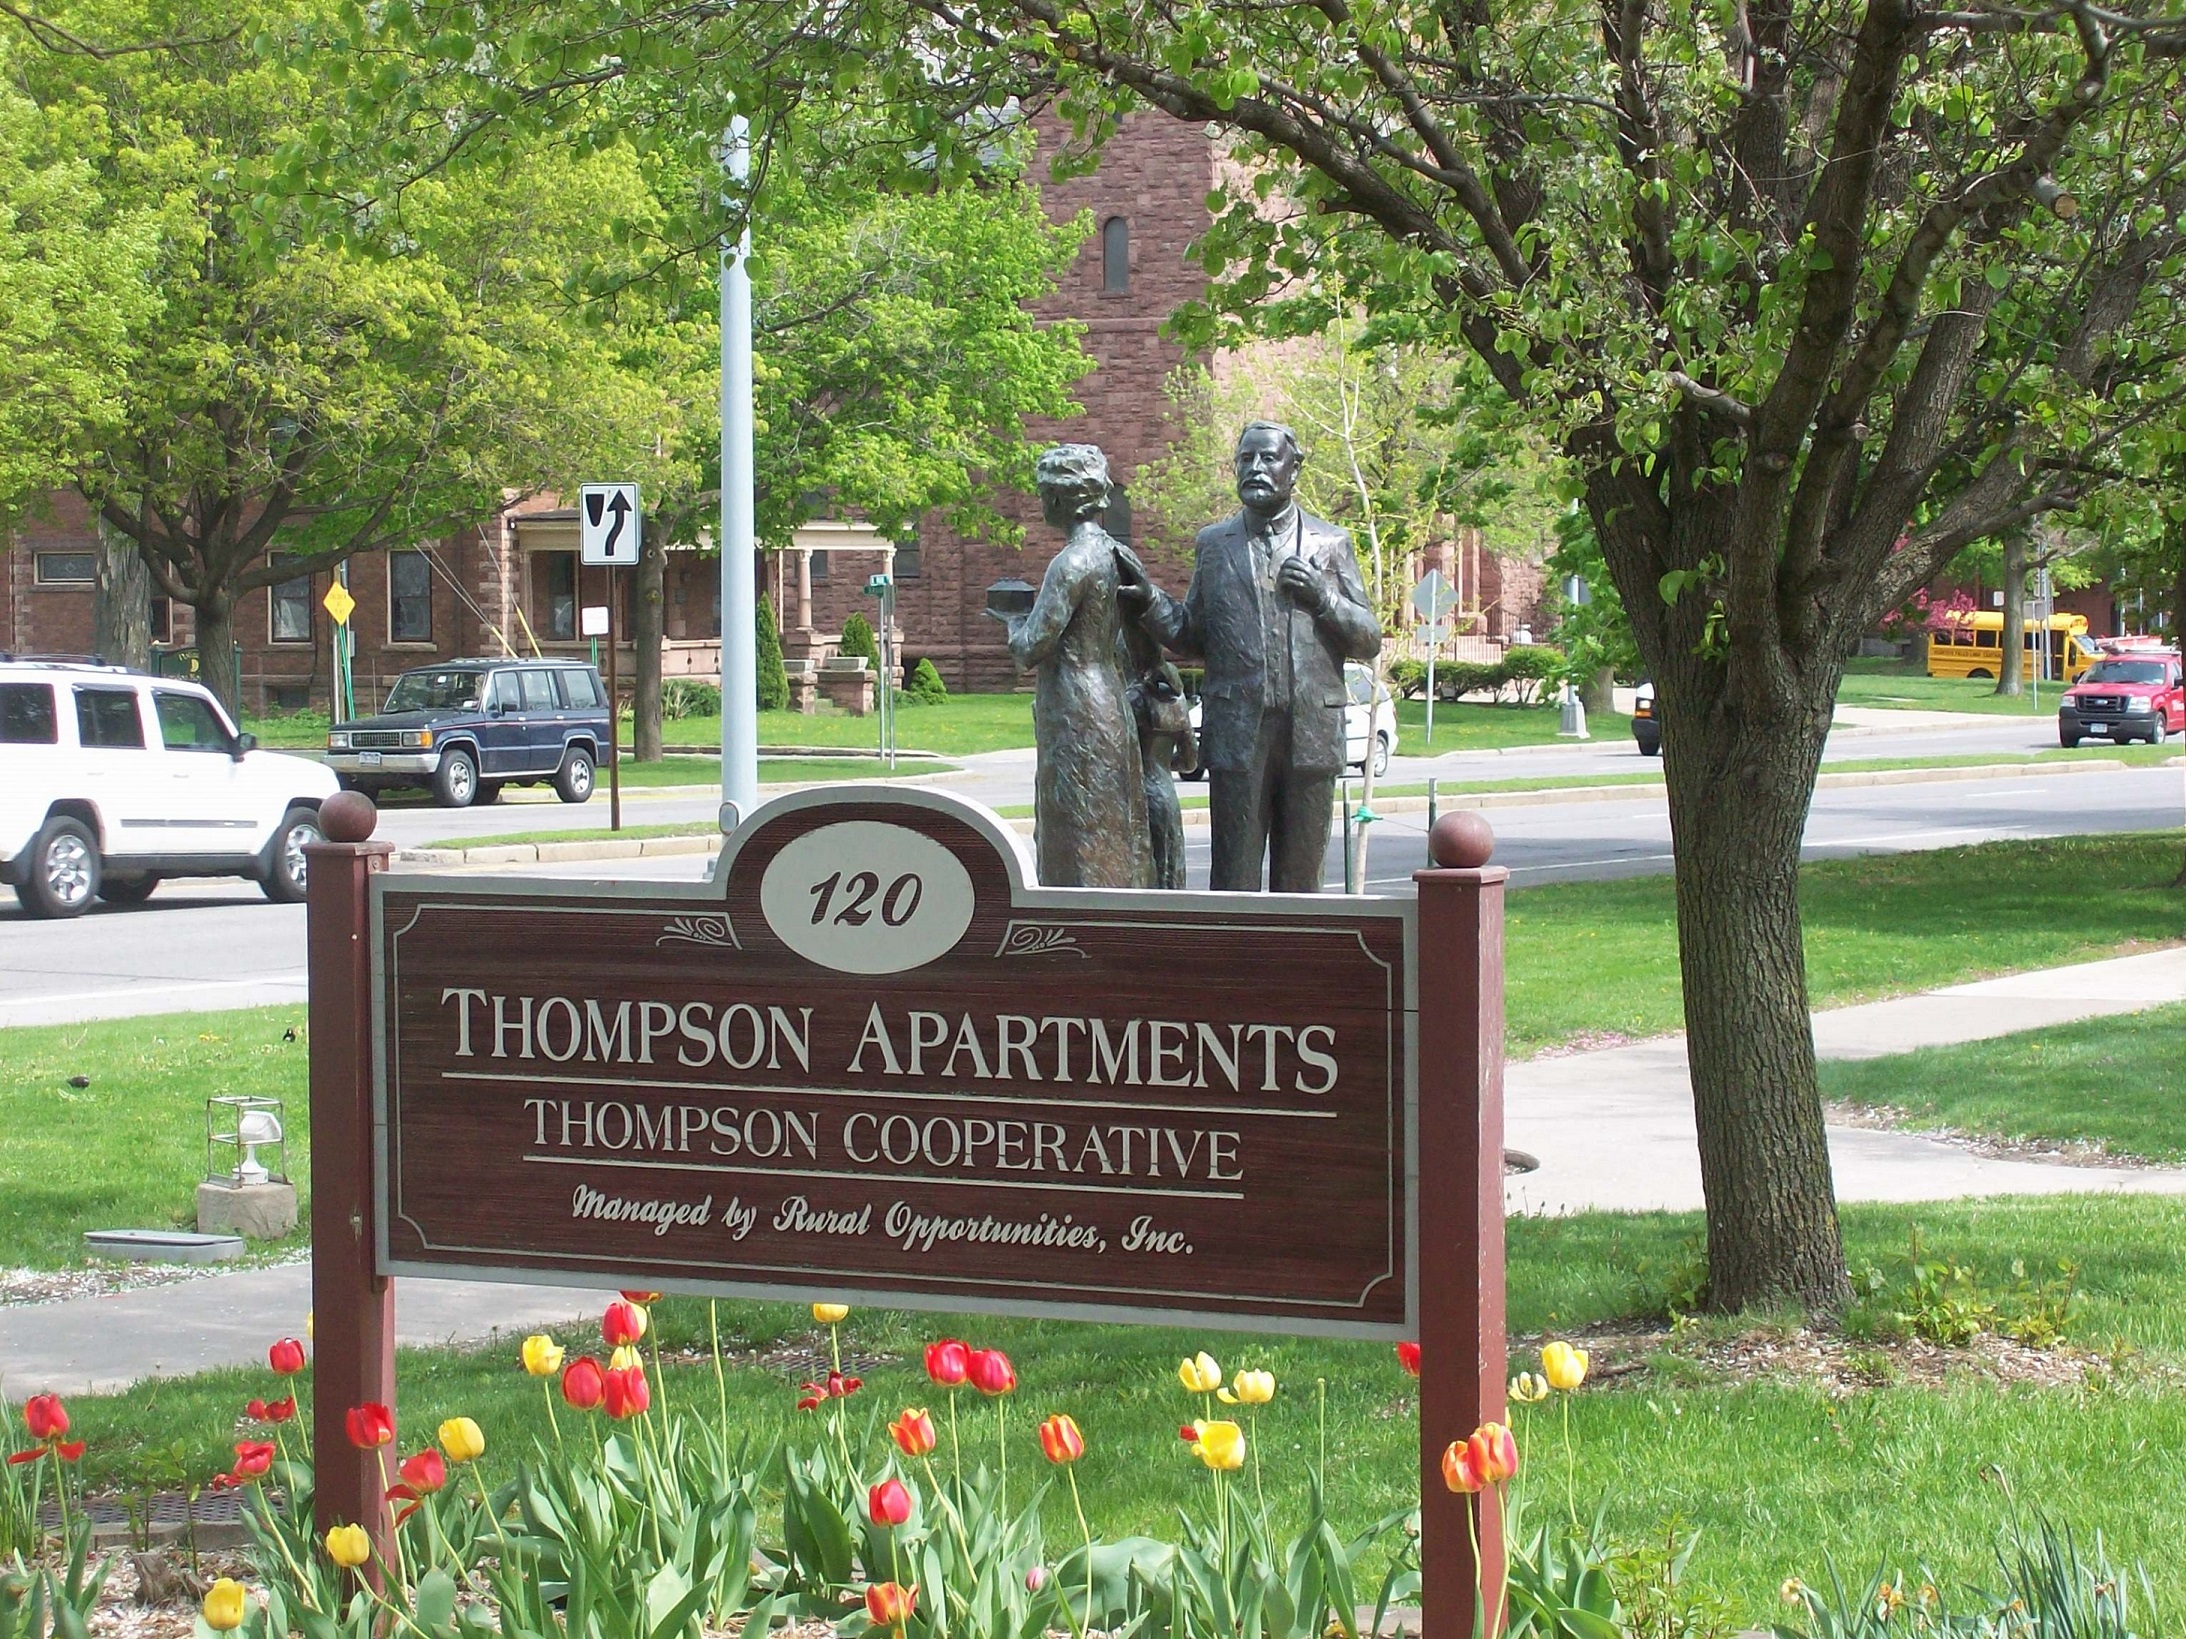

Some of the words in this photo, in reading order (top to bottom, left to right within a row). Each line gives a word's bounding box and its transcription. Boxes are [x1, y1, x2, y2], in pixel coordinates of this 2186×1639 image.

[809, 870, 924, 927] 120
[441, 988, 813, 1074] THOMPSON
[846, 1001, 1338, 1094] APARTMENTS
[523, 1099, 818, 1160] THOMPSON
[843, 1112, 1244, 1181] COOPERATIVE
[572, 1184, 712, 1236] Managed
[721, 1196, 757, 1241] by
[772, 1195, 871, 1236] Rural
[884, 1200, 1106, 1253] Opportunities,
[1121, 1215, 1194, 1254] Inc.
